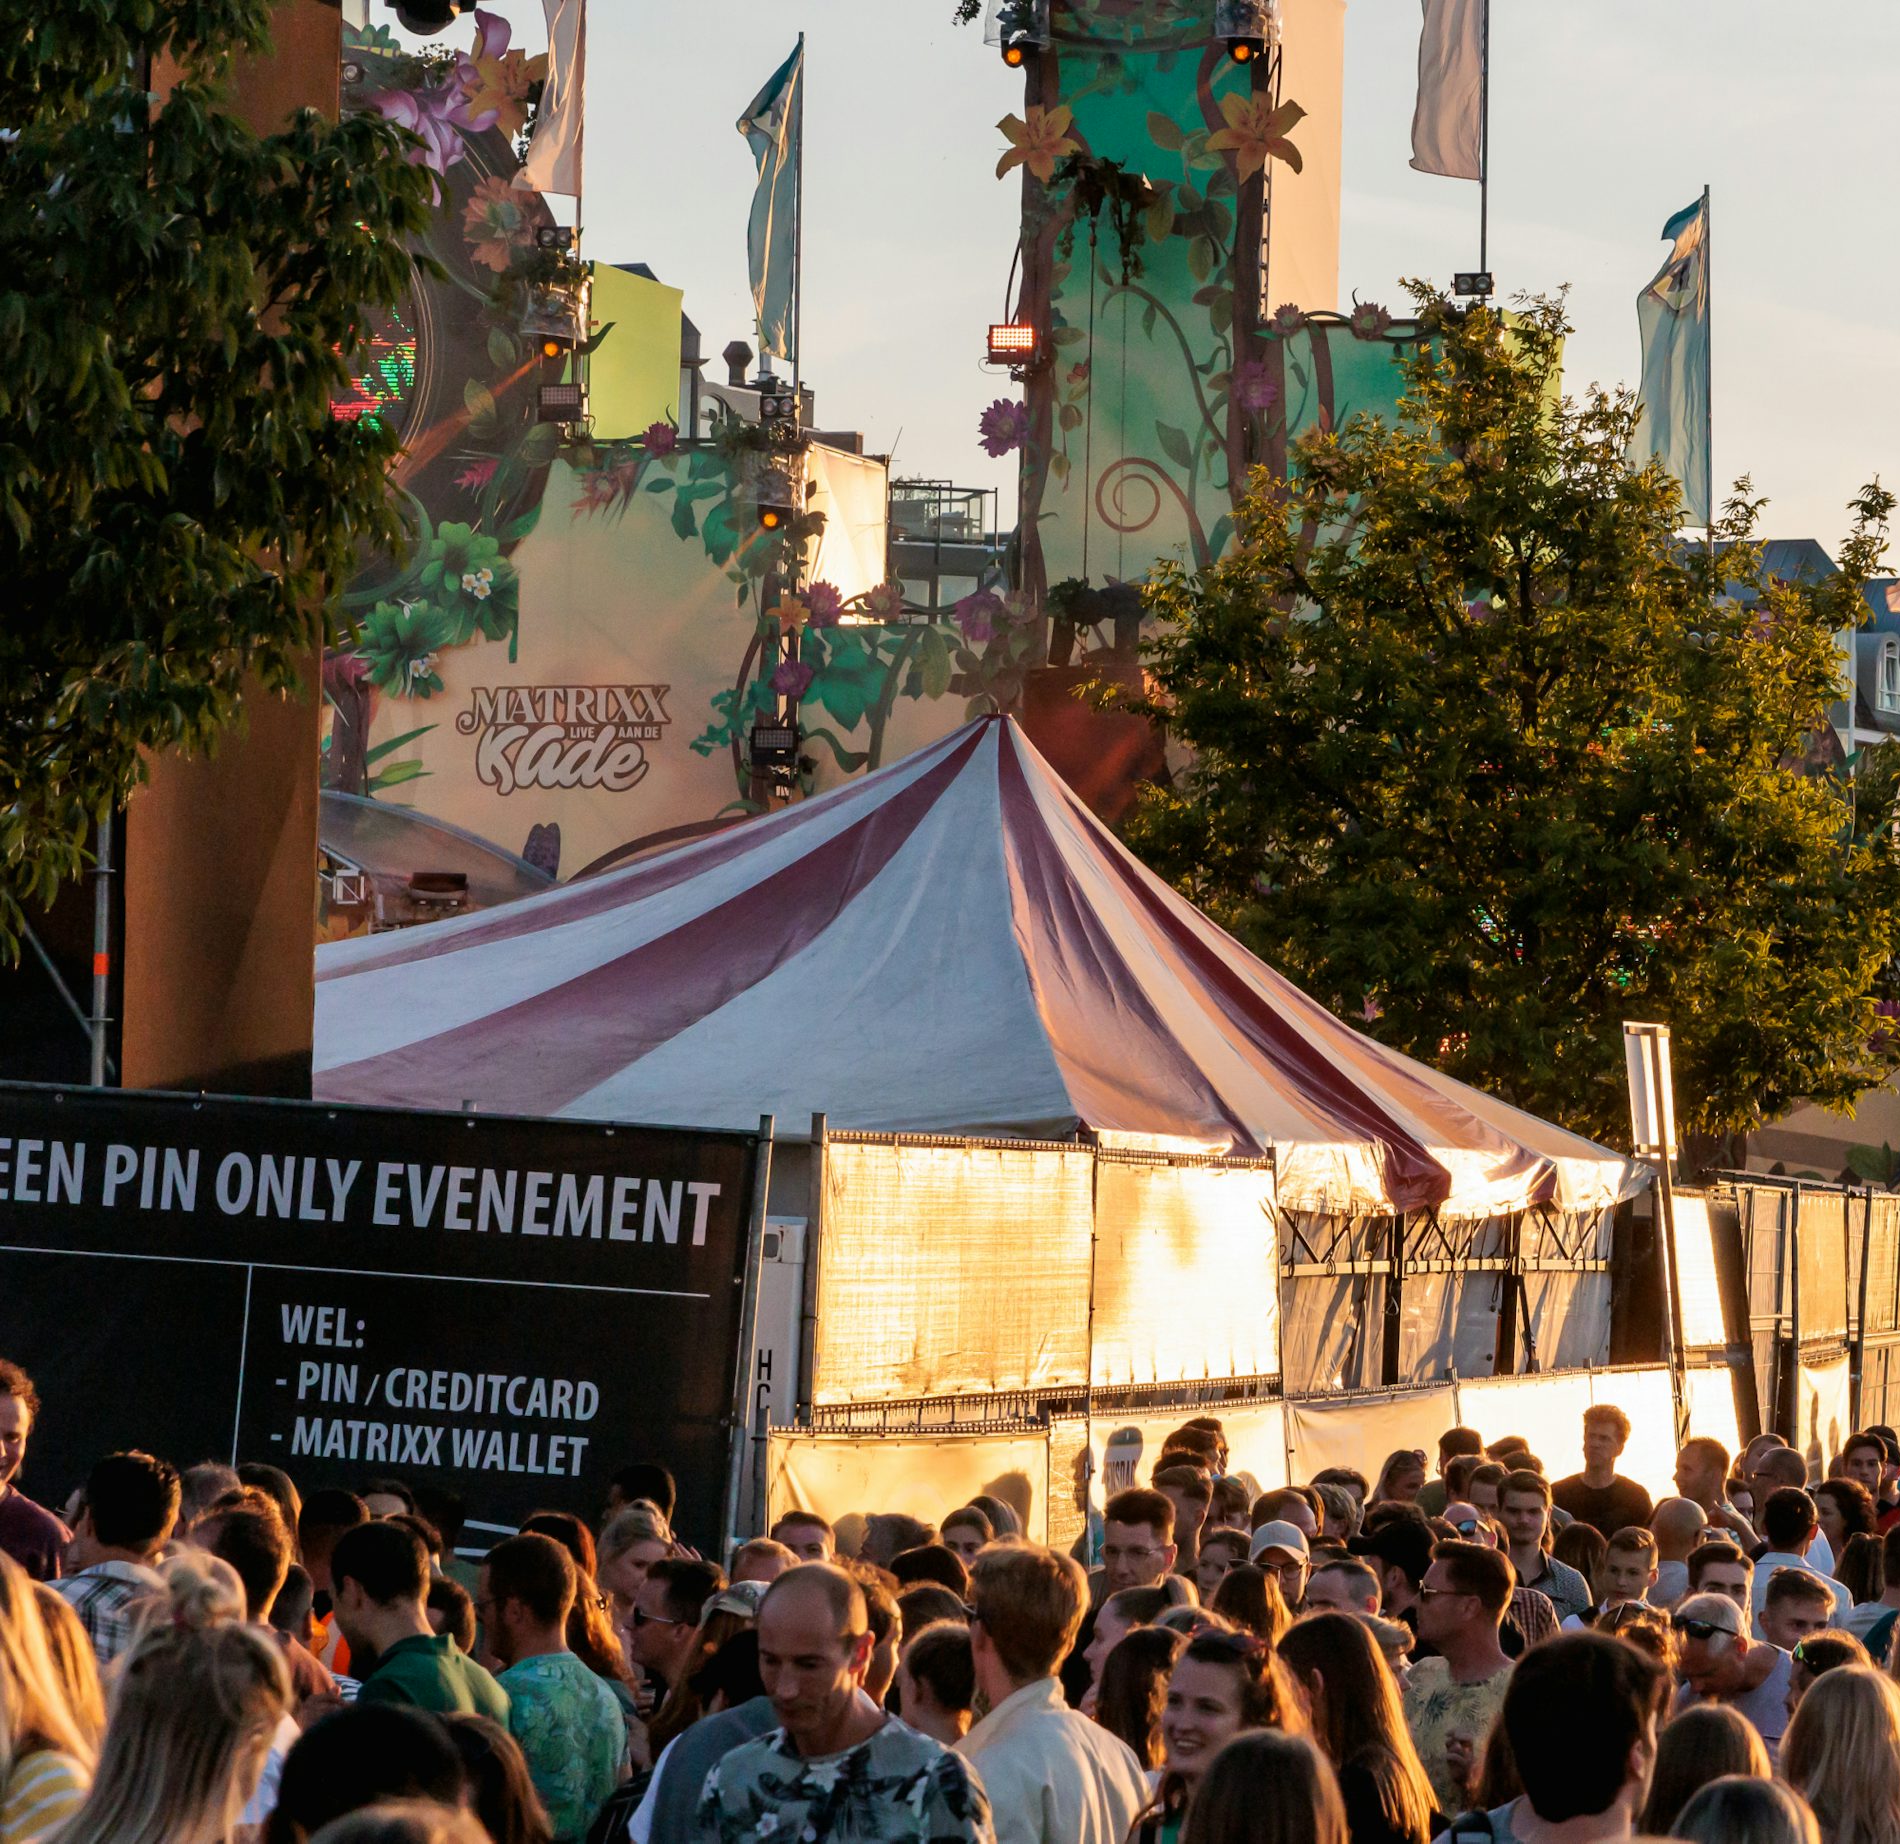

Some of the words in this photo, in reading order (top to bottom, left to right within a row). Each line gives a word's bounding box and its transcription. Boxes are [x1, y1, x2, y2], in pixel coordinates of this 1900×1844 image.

[458, 686, 670, 734] MATRIXX
[569, 726, 595, 739] LIVE
[618, 726, 642, 739] AAN
[644, 726, 659, 739] DE
[477, 724, 649, 796] Kade
[102, 1144, 200, 1212] PIN
[216, 1152, 363, 1222] ONLY
[372, 1162, 722, 1246] EVENEMENT
[281, 1303, 366, 1349] WEL:
[298, 1361, 358, 1404] PIN
[291, 1416, 445, 1466] MATRIXX
[452, 1428, 589, 1476] WALLET
